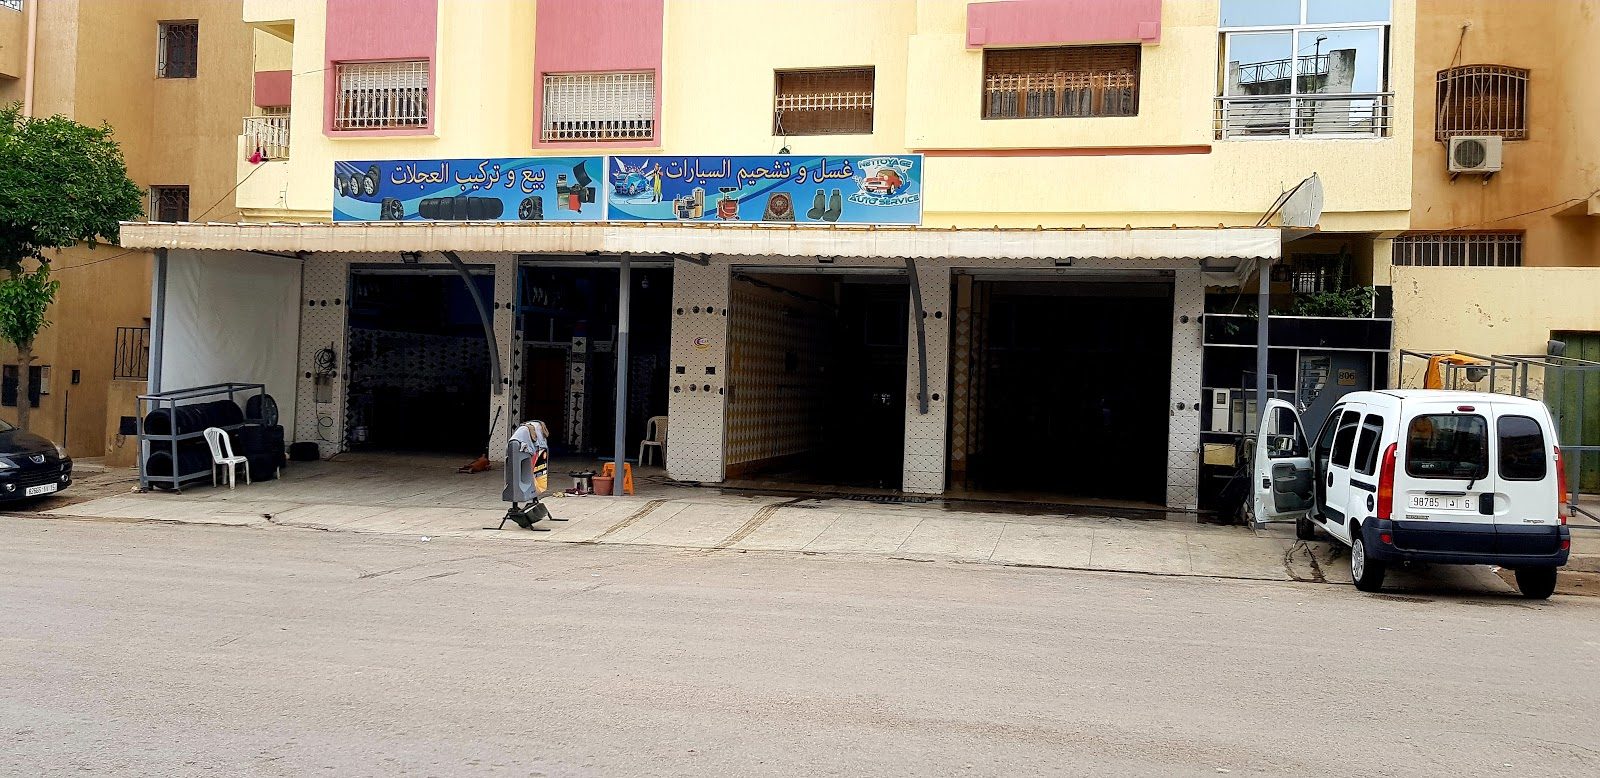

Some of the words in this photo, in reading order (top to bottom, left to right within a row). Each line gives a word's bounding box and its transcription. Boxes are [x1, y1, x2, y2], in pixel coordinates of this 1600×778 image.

[665, 158, 732, 185] السيارات
[795, 165, 808, 185] و
[813, 158, 854, 184] غسل
[858, 158, 914, 169] NETTOYAGE
[390, 161, 449, 190] العجلات
[454, 160, 500, 191] تركيب
[504, 169, 516, 189] و
[520, 168, 546, 194] بيع
[737, 160, 792, 191] تشحيم
[849, 194, 879, 205] AUTO
[879, 194, 919, 206] SERVICE
[1338, 371, 1355, 380] 806
[1413, 497, 1440, 507] 98785
[1464, 499, 1470, 509] 6
